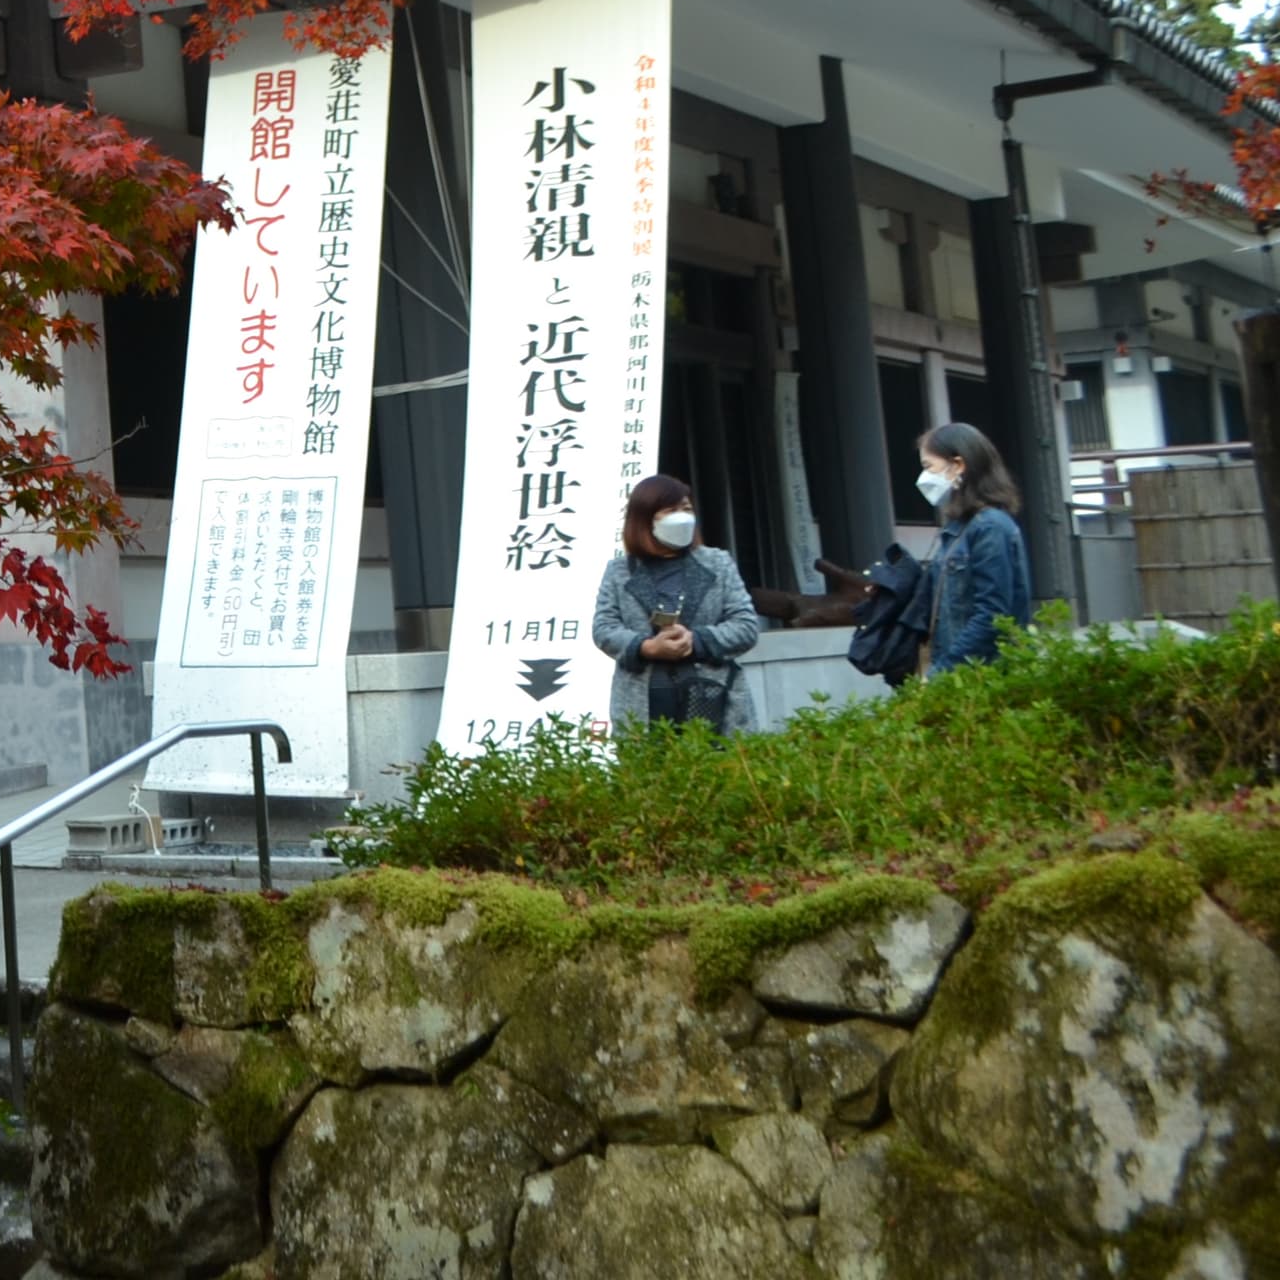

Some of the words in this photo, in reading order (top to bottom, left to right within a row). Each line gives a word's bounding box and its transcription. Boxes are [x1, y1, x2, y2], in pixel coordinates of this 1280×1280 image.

[236, 69, 296, 404] 開館しています
[302, 56, 362, 455] 愛荘町立歴史文化博物館
[504, 66, 597, 571] 小林清親と近代浮世絵
[485, 616, 579, 645] 11月1日
